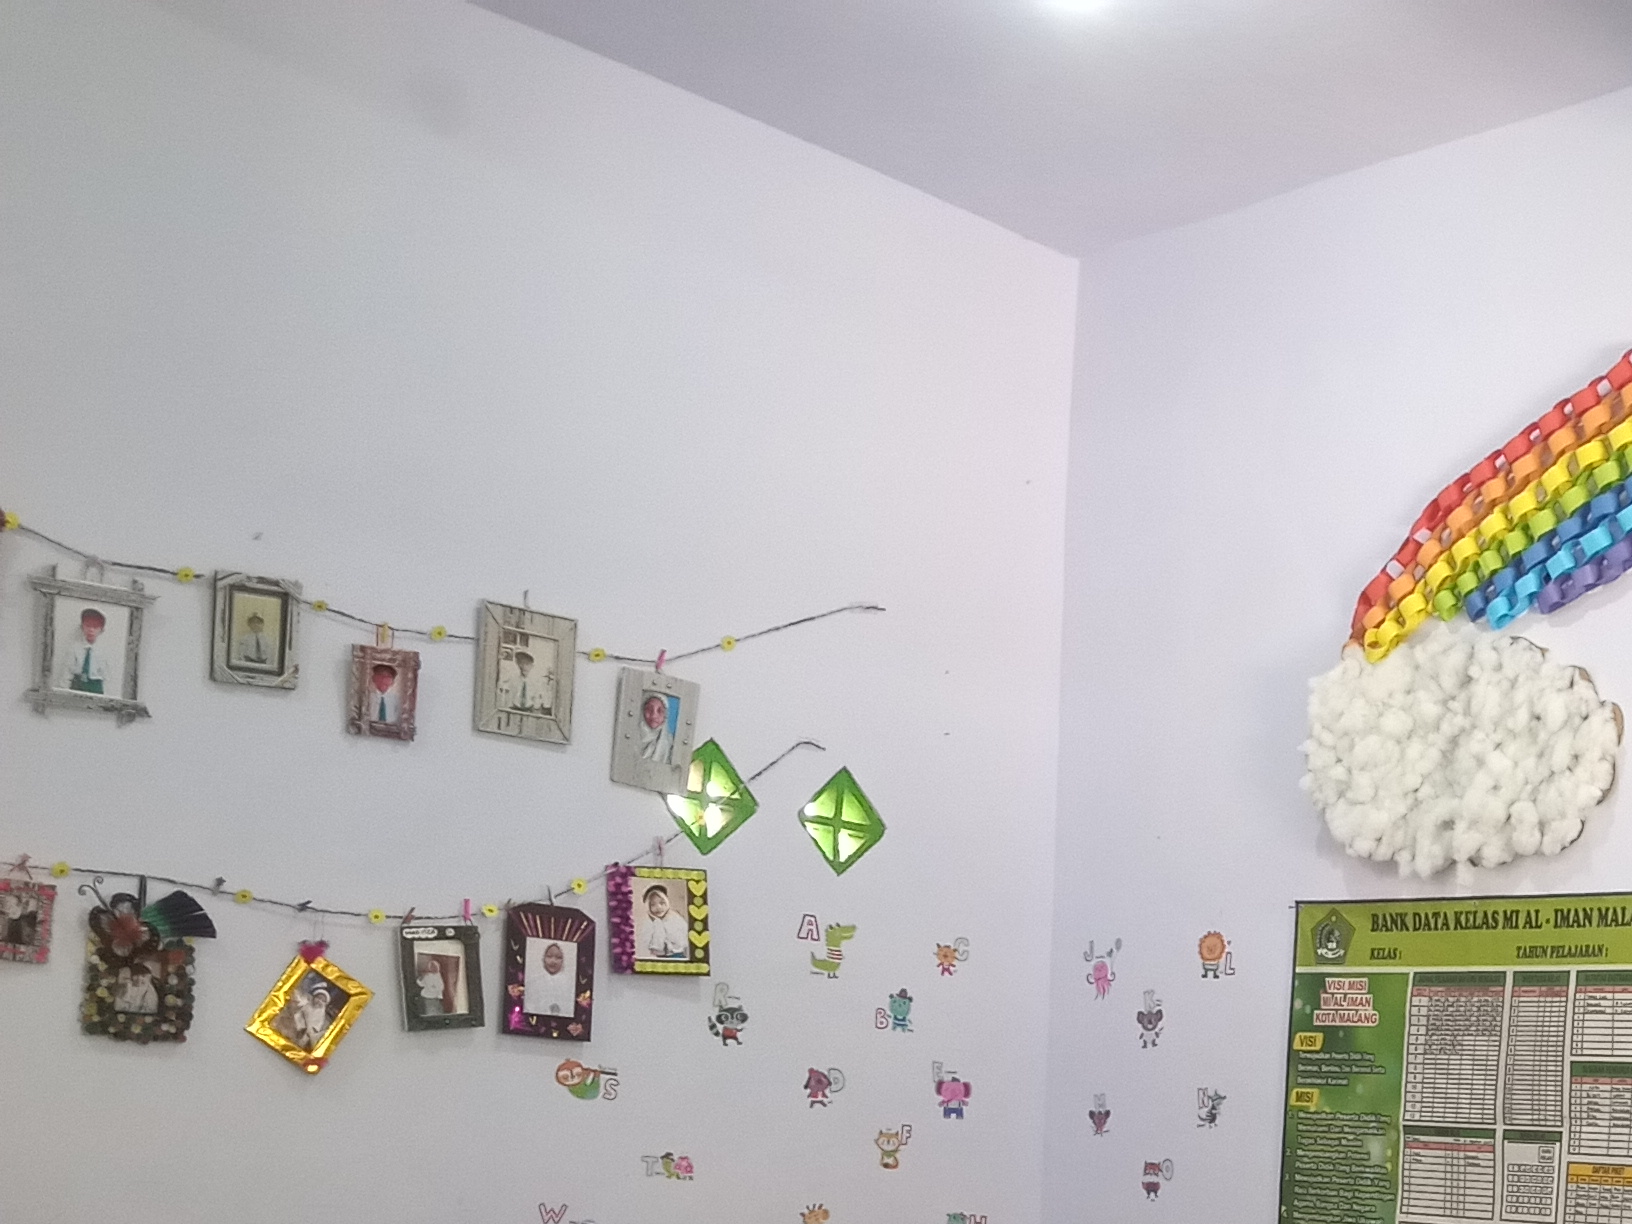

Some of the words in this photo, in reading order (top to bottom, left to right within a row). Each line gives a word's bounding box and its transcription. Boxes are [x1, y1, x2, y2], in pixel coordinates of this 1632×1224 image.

[797, 914, 820, 941] A
[1370, 912, 1410, 932] BANK
[1412, 911, 1450, 931] DATA
[1453, 909, 1499, 931] KELAS
[1501, 909, 1520, 930] MI
[1522, 909, 1543, 929] AL
[1553, 907, 1594, 929] IMAN
[953, 937, 970, 961] C
[1083, 940, 1094, 962] J
[1516, 945, 1549, 959] TAHUN
[1549, 944, 1604, 958] PELAJARAN
[1224, 951, 1235, 975] L
[713, 982, 729, 1007] R
[1327, 980, 1345, 991] VISI
[1348, 980, 1367, 991] MISI
[875, 1008, 889, 1029] B
[1315, 1012, 1337, 1024] KOTA
[1338, 1012, 1378, 1024] MALANG
[1299, 1035, 1317, 1048] VISI
[603, 1078, 620, 1100] S
[828, 1068, 845, 1092] D
[1295, 1091, 1315, 1103] MISI
[901, 1124, 912, 1145] F
[641, 1155, 660, 1176] T
[1161, 1159, 1174, 1180] O
